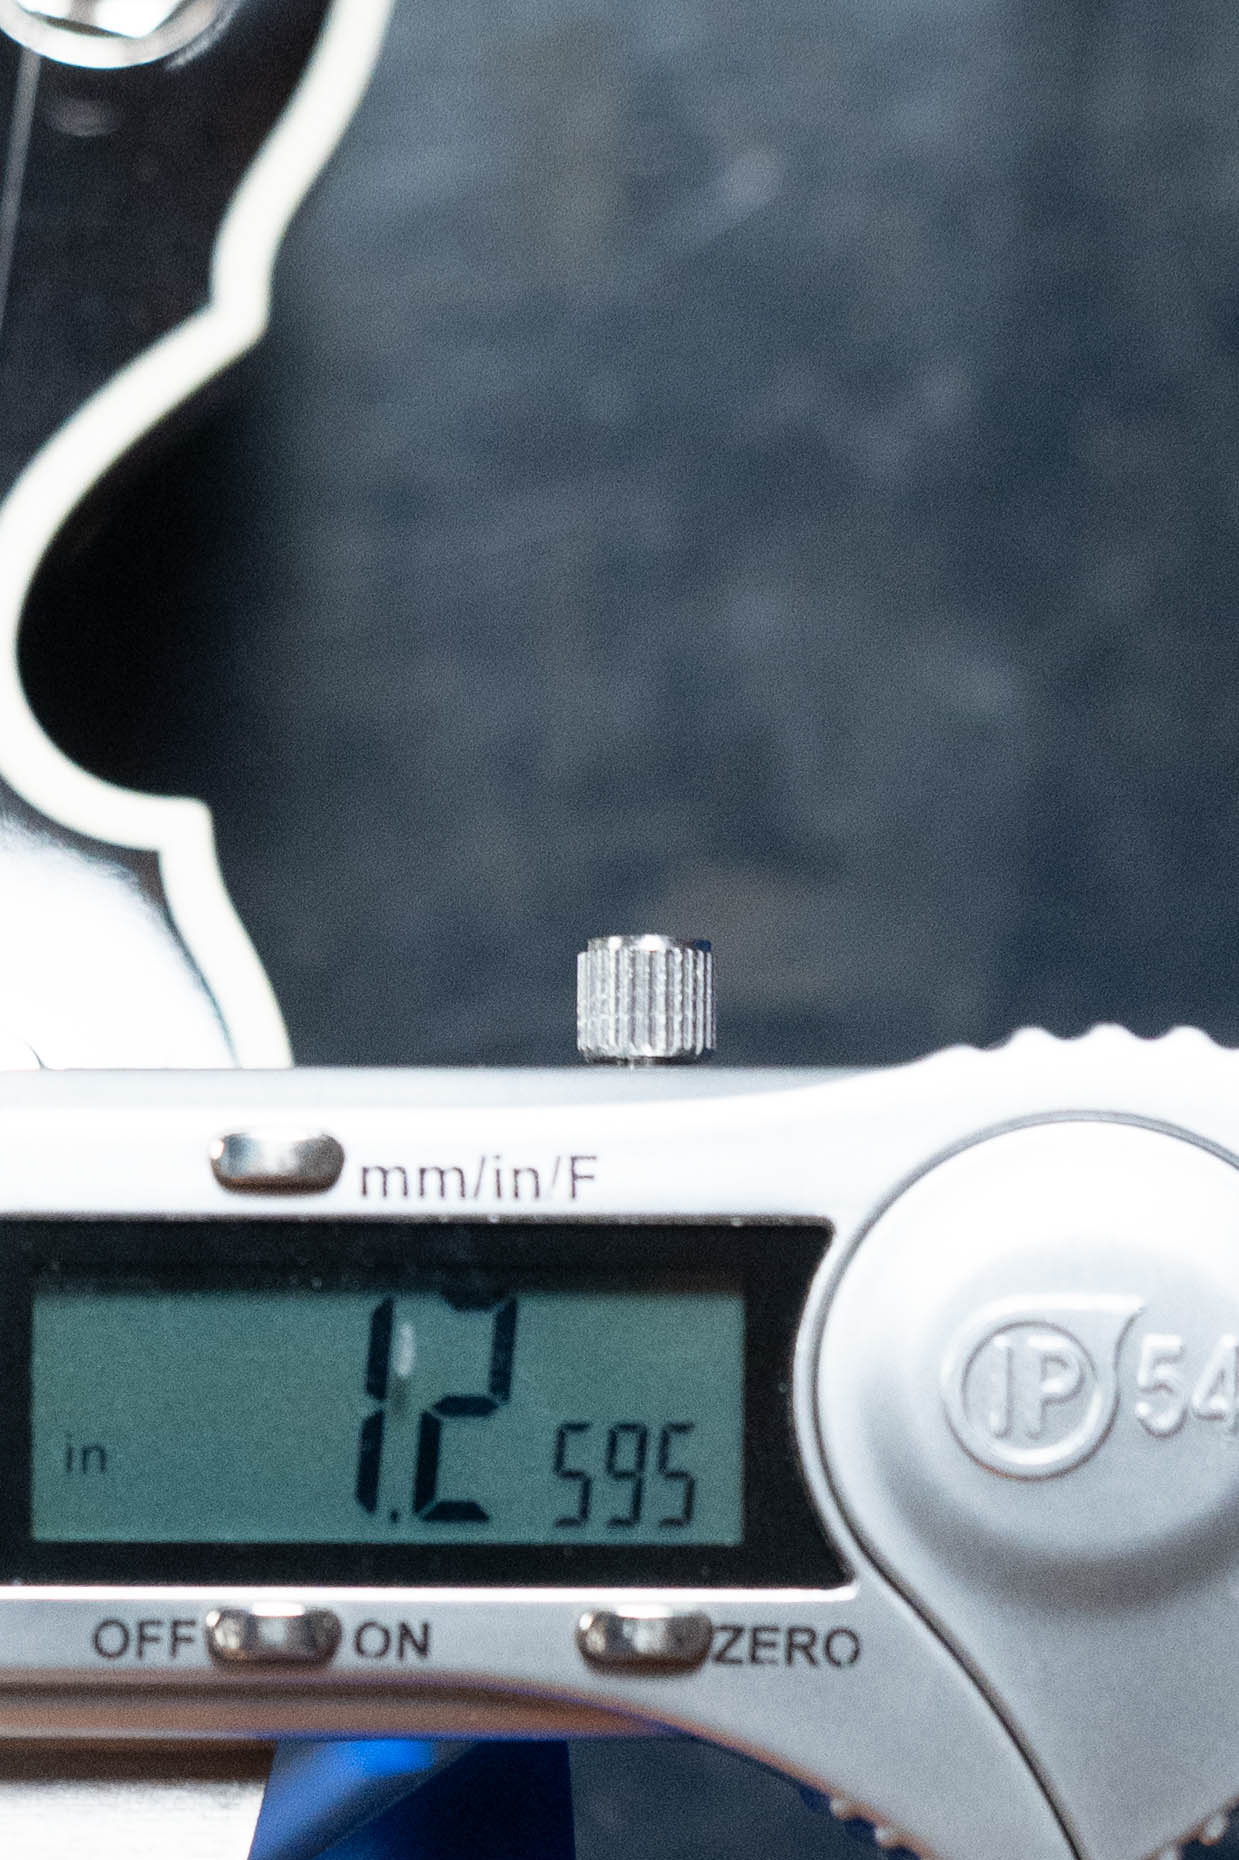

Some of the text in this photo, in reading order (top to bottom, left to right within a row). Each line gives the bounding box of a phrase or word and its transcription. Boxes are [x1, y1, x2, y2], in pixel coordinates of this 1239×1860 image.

[360, 1155, 598, 1202] mm/in/F
[986, 1332, 1239, 1442] IP 54
[65, 1437, 107, 1475] in
[92, 1618, 862, 1669] OFF ON ZERO
